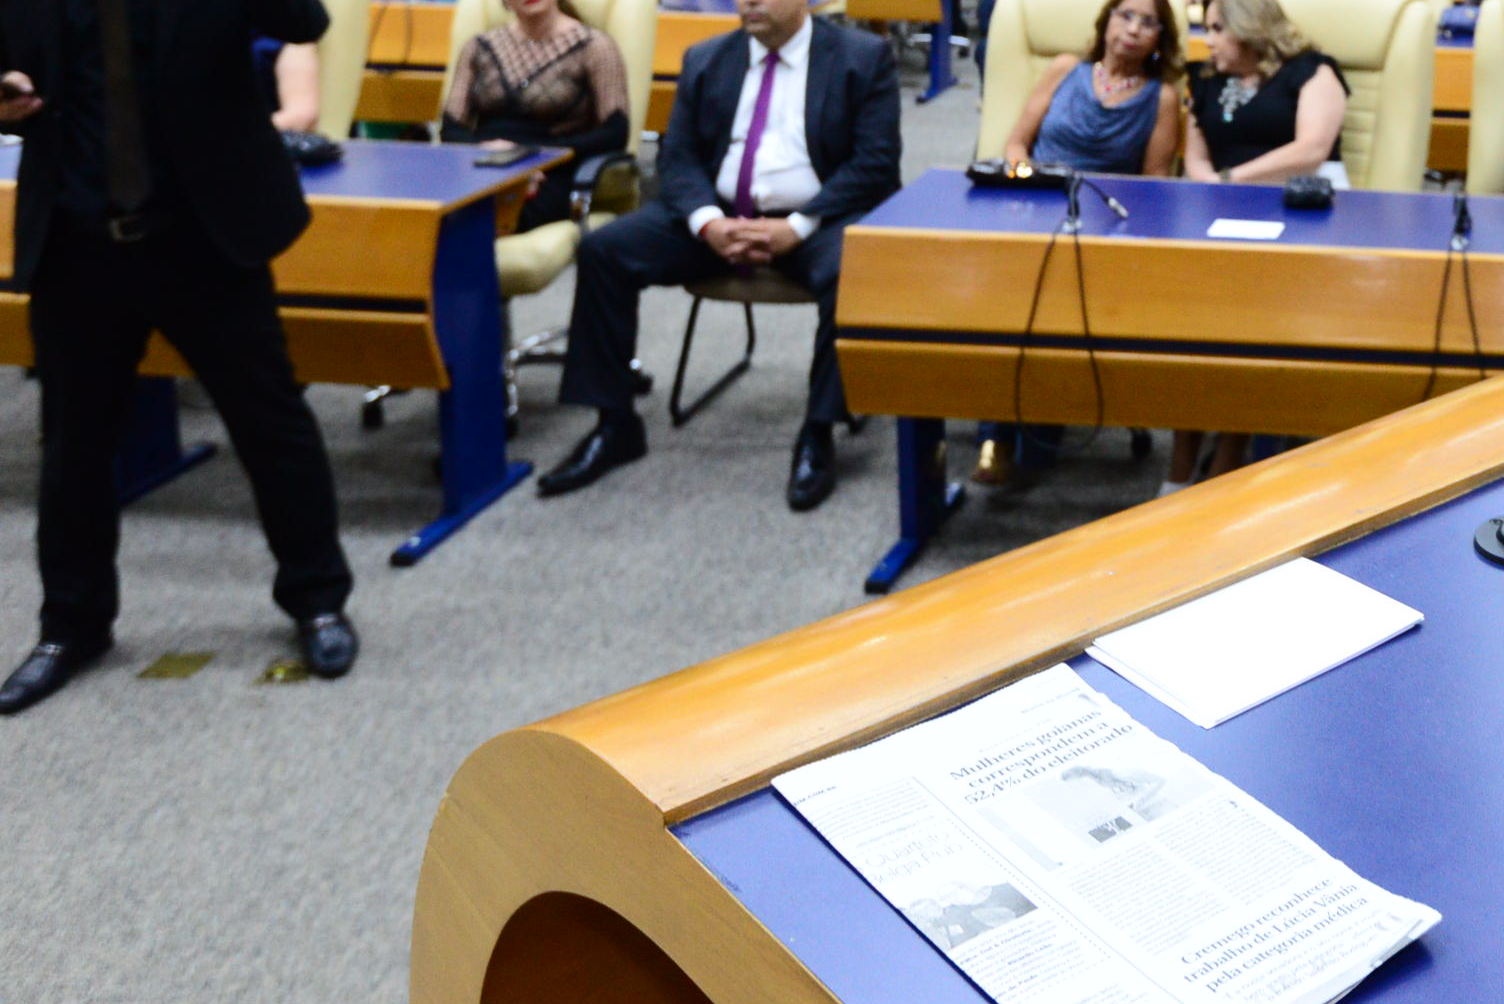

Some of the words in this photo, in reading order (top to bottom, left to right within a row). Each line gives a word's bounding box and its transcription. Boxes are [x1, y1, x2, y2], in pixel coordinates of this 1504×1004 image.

[949, 739, 1035, 780] Mulheres
[1035, 710, 1102, 746] goianas
[964, 776, 1022, 805] 52,4%
[1022, 766, 1047, 780] do
[1048, 724, 1133, 768] eleitorado
[968, 728, 1096, 788] correspondem
[1098, 721, 1109, 731] a
[1181, 921, 1256, 964] Cremego
[1256, 879, 1332, 925] reconhece
[1183, 943, 1253, 983] trabalho
[1253, 931, 1272, 944] de
[1272, 907, 1316, 934] Lúcia
[1313, 884, 1358, 908] Vânia
[1205, 967, 1242, 994] pela
[1242, 928, 1313, 969] categoria
[1313, 897, 1368, 931] médica
